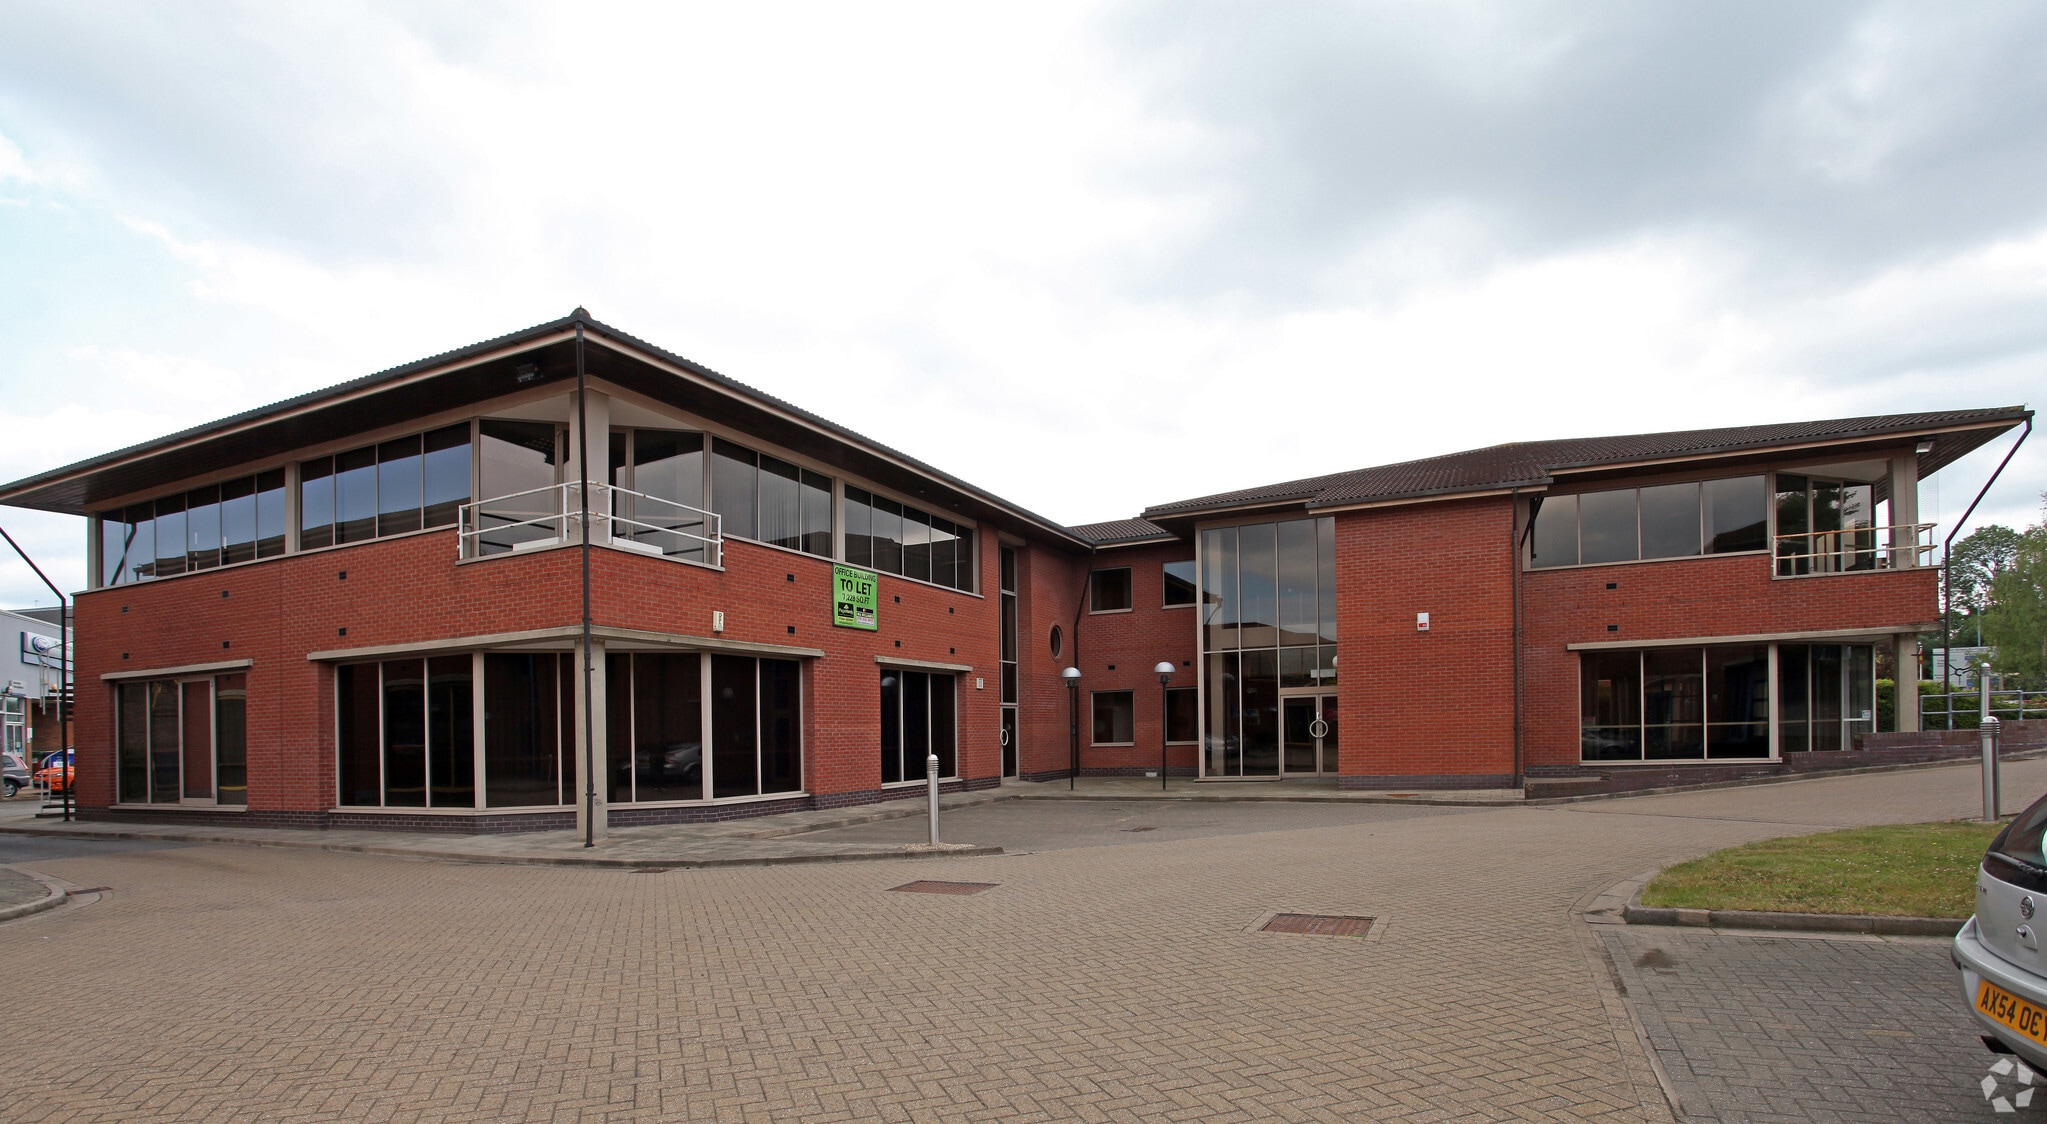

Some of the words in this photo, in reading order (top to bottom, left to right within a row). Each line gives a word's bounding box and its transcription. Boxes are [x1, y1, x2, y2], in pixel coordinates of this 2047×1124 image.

[835, 567, 853, 578] OFFICE
[854, 572, 876, 583] BUILDING
[840, 578, 853, 592] TO
[856, 581, 872, 596] LET
[1980, 986, 2016, 1023] AX54
